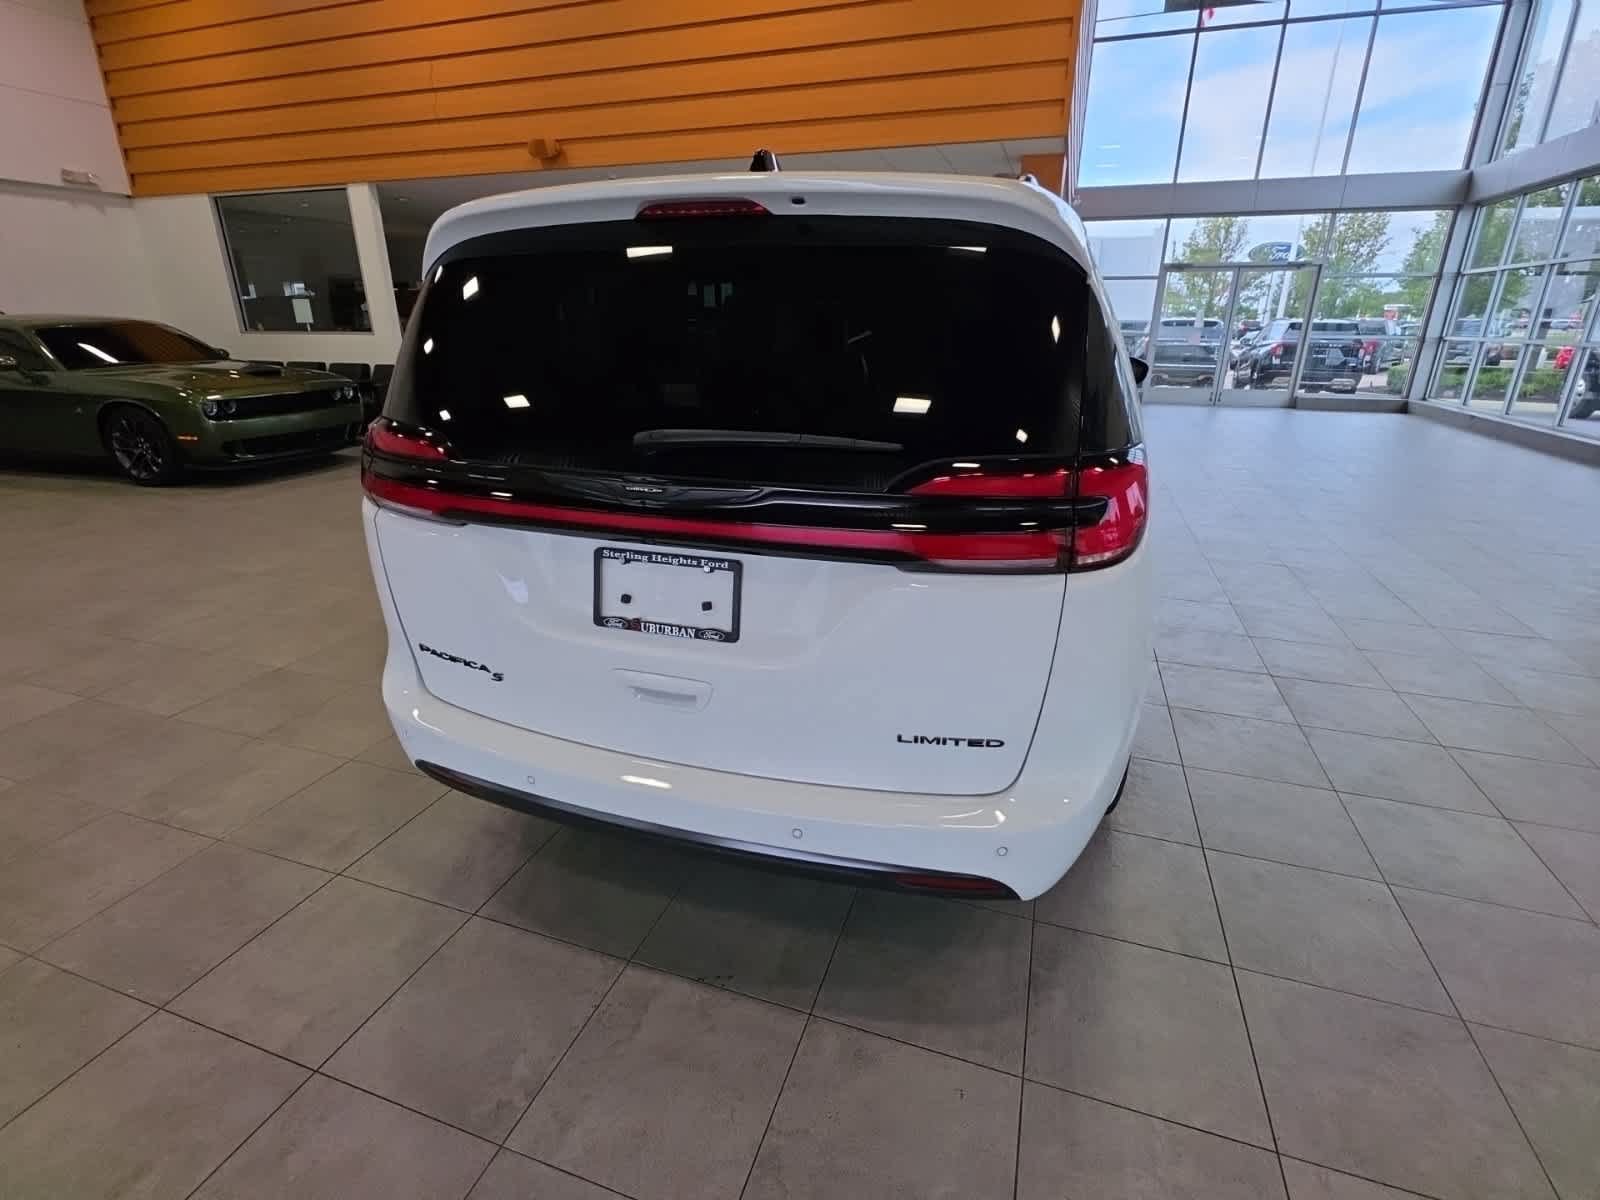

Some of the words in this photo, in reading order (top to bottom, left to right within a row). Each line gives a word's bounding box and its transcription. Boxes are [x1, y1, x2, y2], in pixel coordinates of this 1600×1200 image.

[602, 549, 648, 562] Sterling
[652, 553, 698, 567] Heights
[700, 559, 729, 569] Ford
[605, 617, 626, 629] Ford
[631, 617, 695, 638] SUBURBAN
[419, 642, 491, 673] PACIFICA
[491, 672, 504, 682] S
[897, 734, 1005, 747] LIMITED
